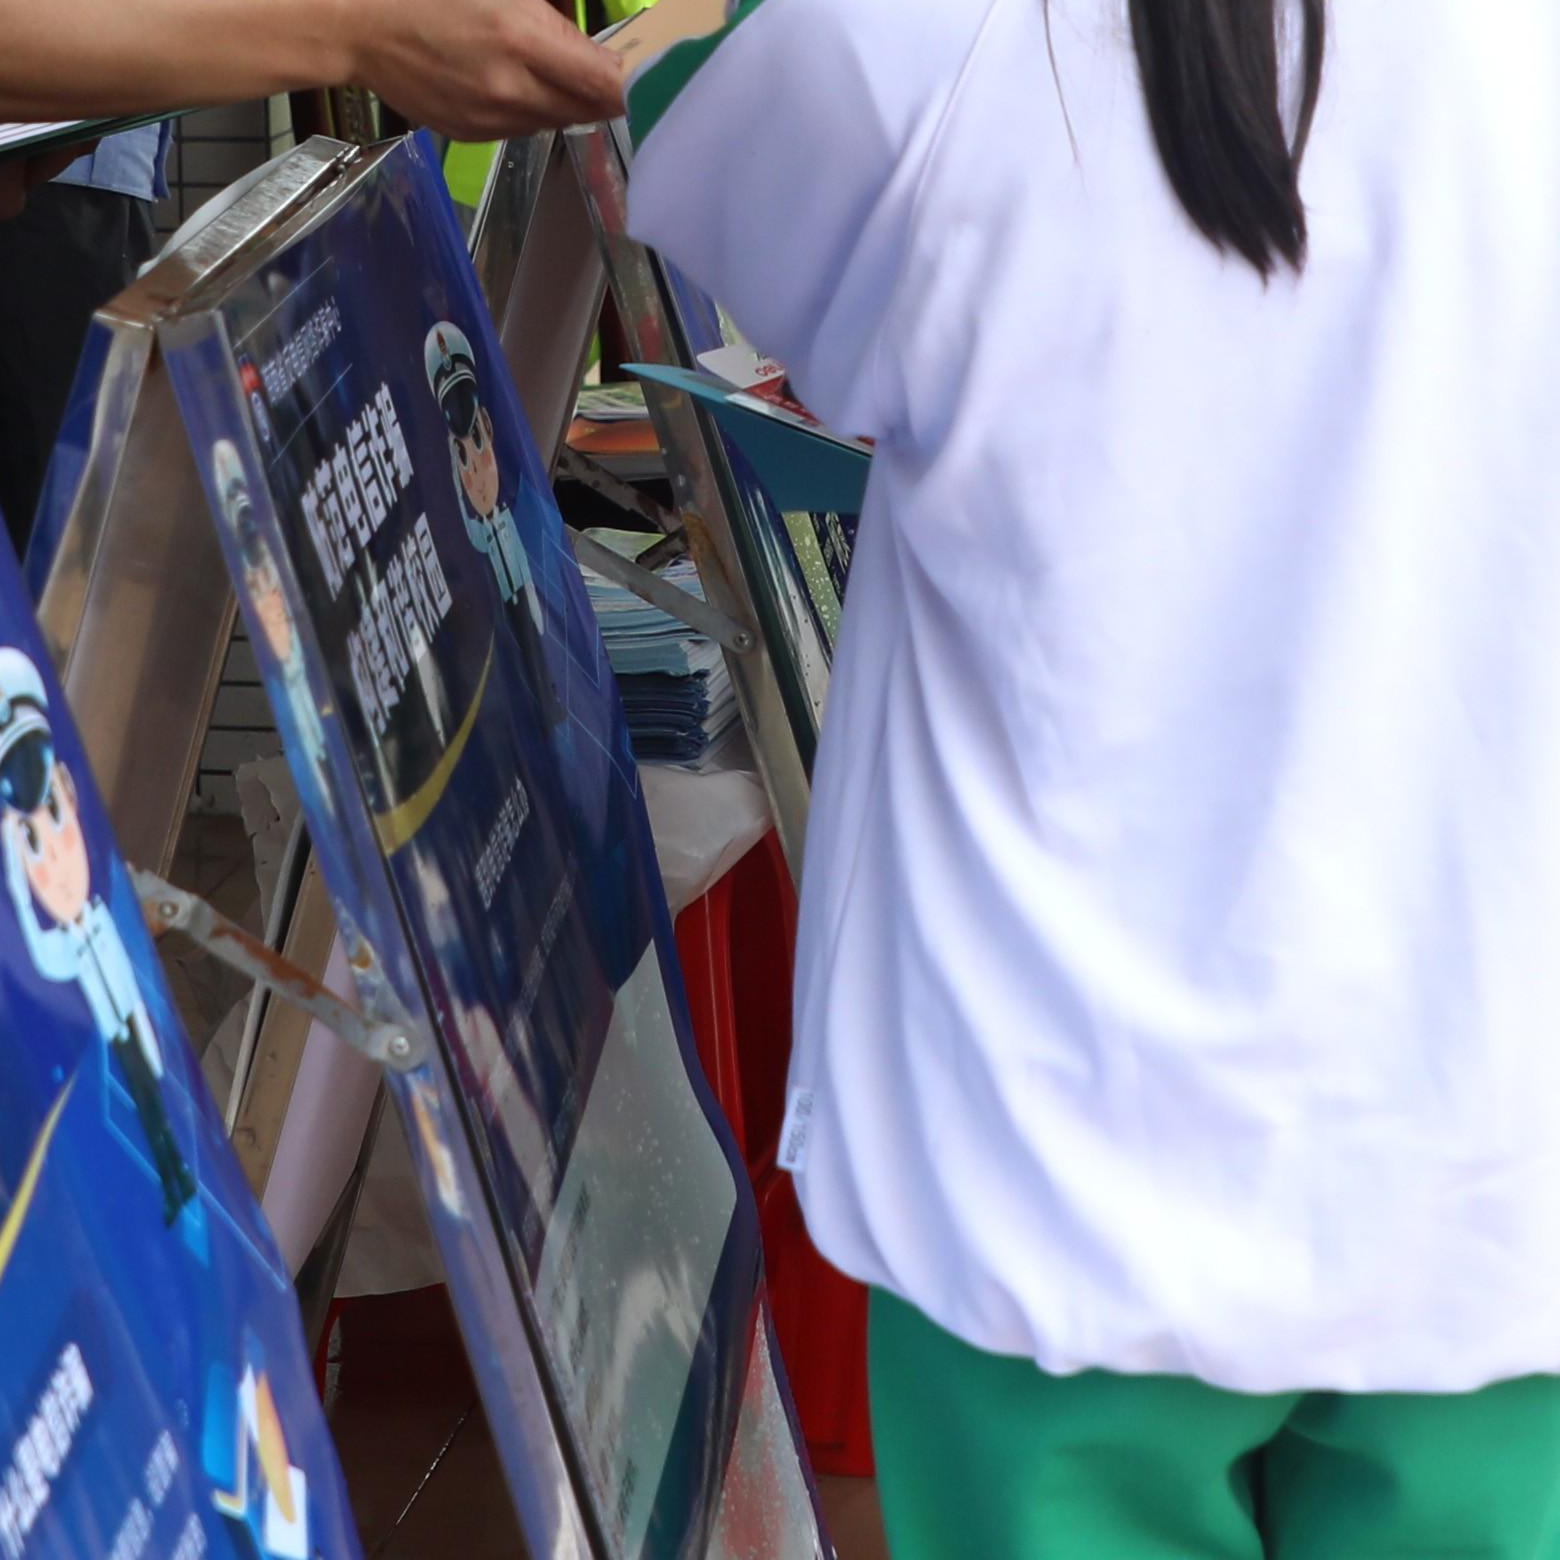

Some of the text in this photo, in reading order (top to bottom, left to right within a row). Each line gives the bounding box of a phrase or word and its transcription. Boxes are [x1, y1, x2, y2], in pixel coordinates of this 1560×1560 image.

[301, 382, 411, 601] 防范电信诈骗
[346, 512, 451, 737] 构建和谐校园
